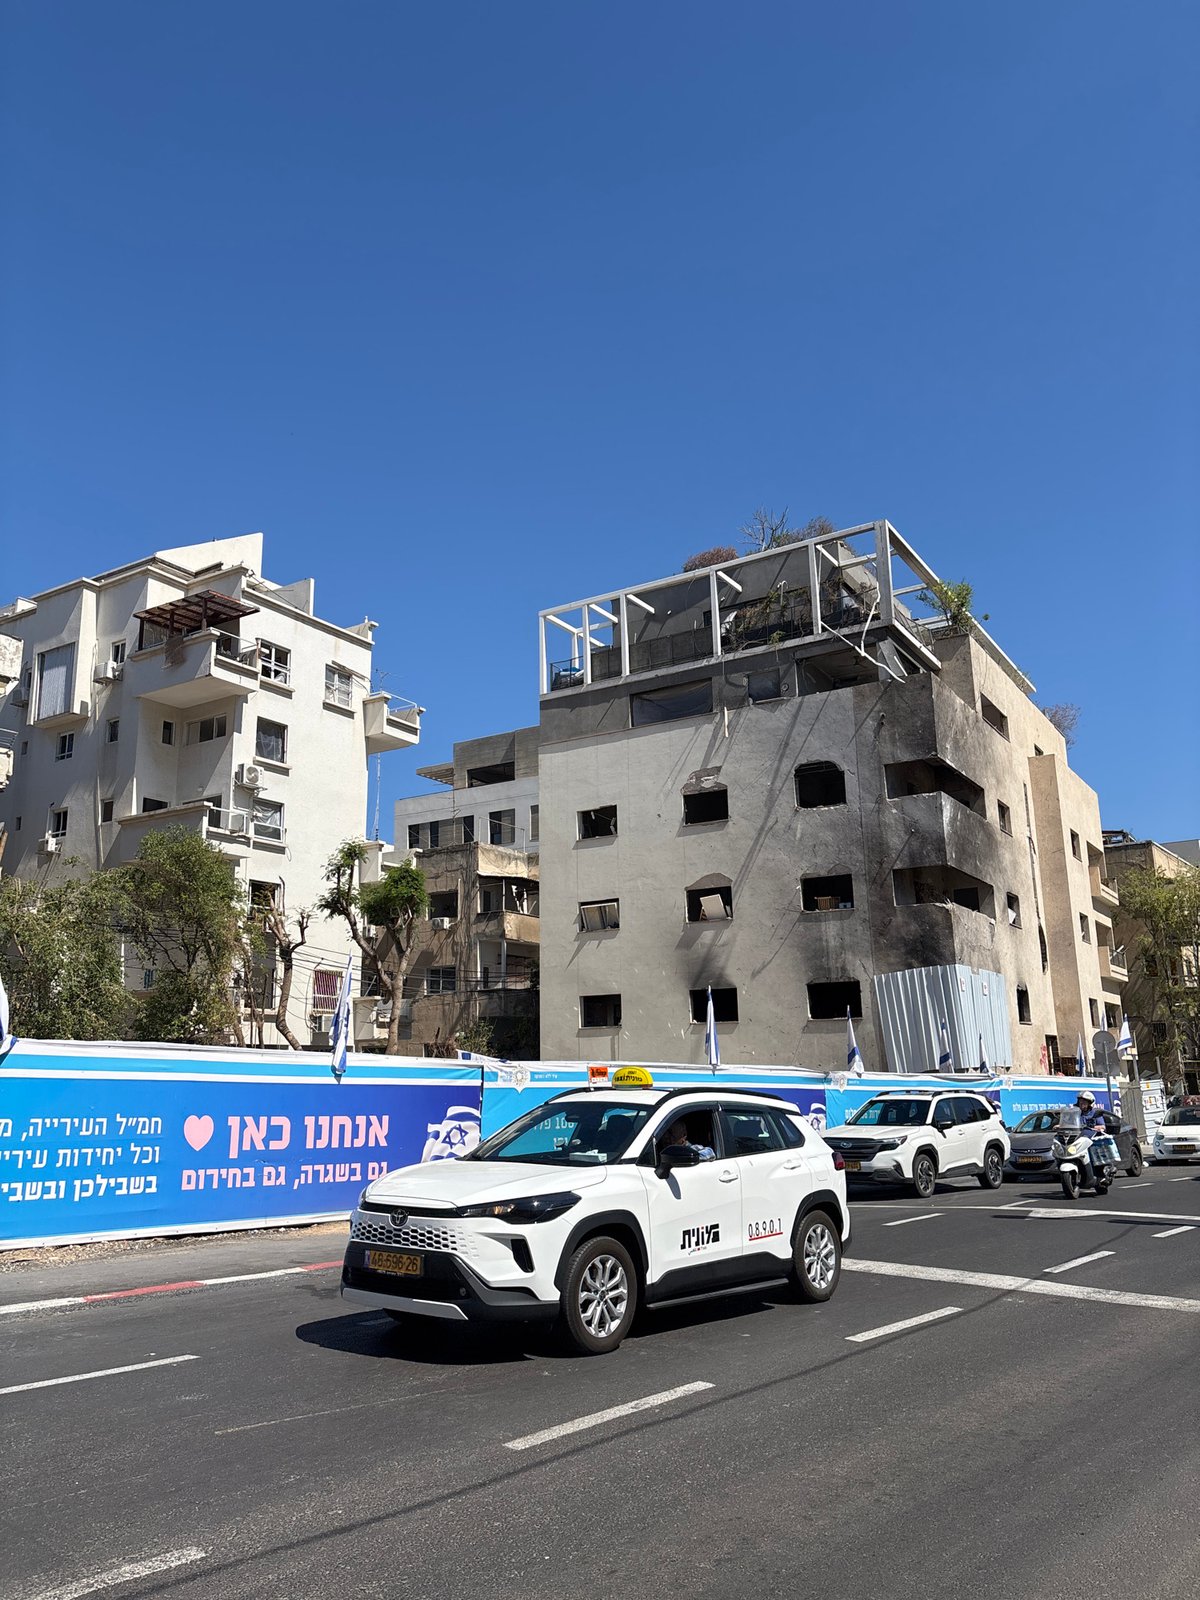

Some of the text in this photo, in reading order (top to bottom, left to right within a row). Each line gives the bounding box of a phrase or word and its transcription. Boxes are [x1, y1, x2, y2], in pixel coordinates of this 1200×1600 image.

[21, 1117, 107, 1142] העירייה,
[227, 1115, 389, 1159] אנחנו כאן
[56, 1147, 122, 1168] יחידות
[130, 1143, 160, 1165] וכל
[73, 1174, 158, 1202] בשבילכן
[181, 1162, 388, 1191] גם בשגרה, גם בחירום
[680, 1223, 720, 1250] מונית
